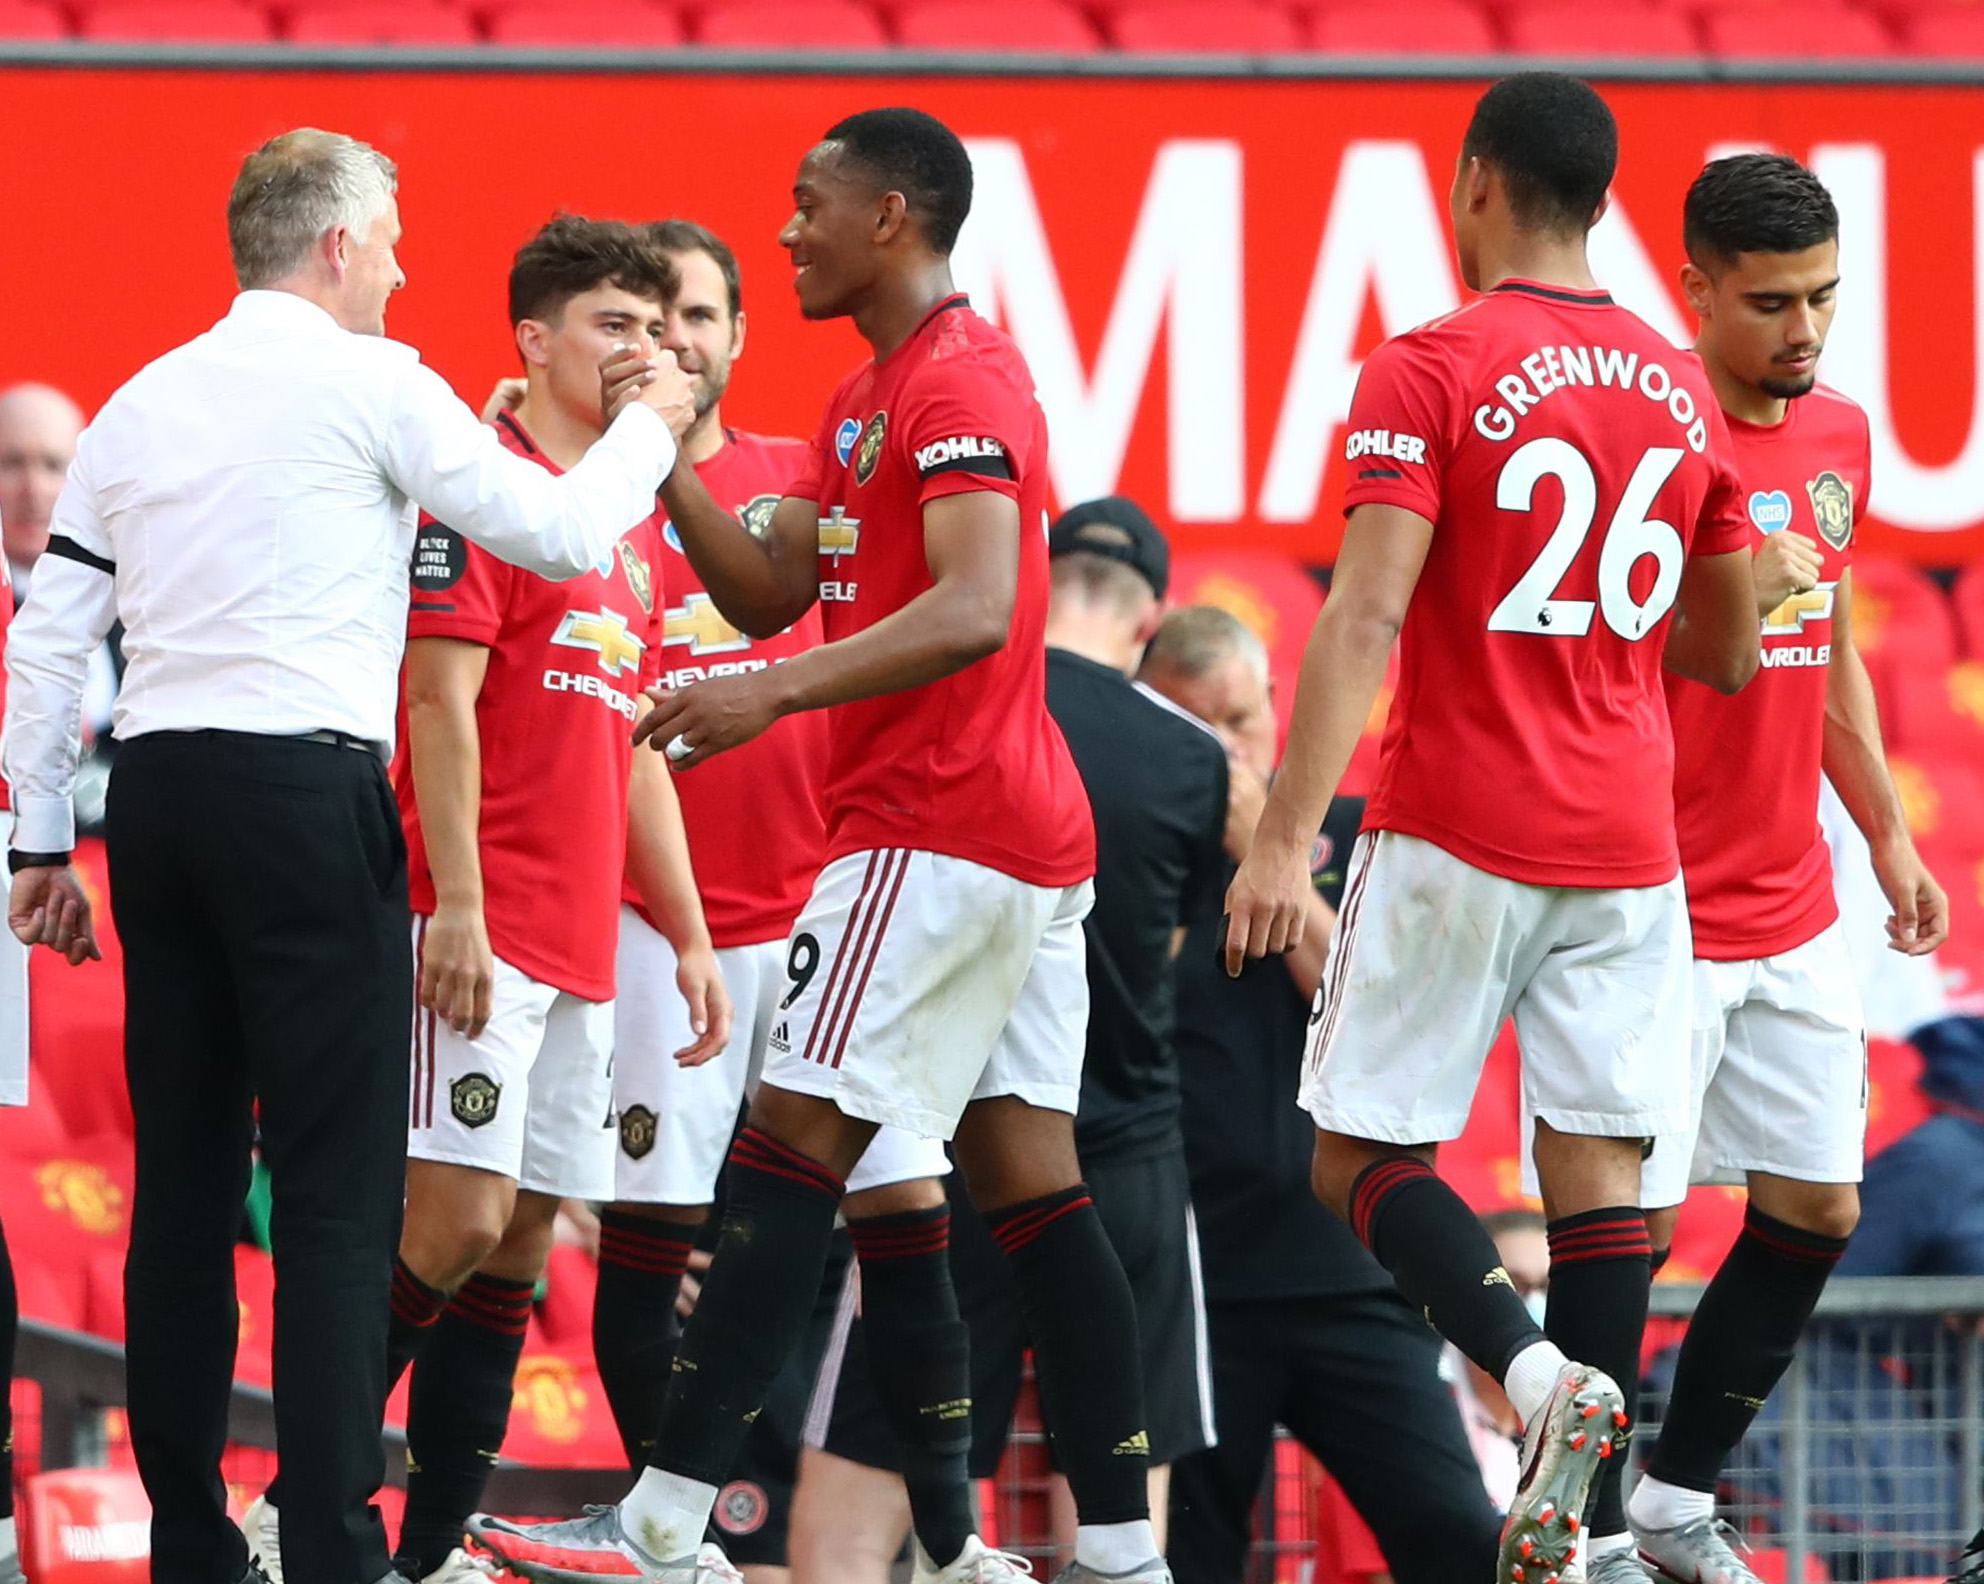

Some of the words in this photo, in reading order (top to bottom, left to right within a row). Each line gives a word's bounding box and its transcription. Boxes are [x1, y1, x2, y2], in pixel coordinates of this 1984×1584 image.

[1474, 345, 1707, 454] GREENWOOD
[1759, 506, 1783, 520] NHS
[420, 552, 447, 564] LIVES
[1487, 436, 1686, 641] 26
[415, 565, 451, 578] MATTER
[779, 931, 821, 1011] 9
